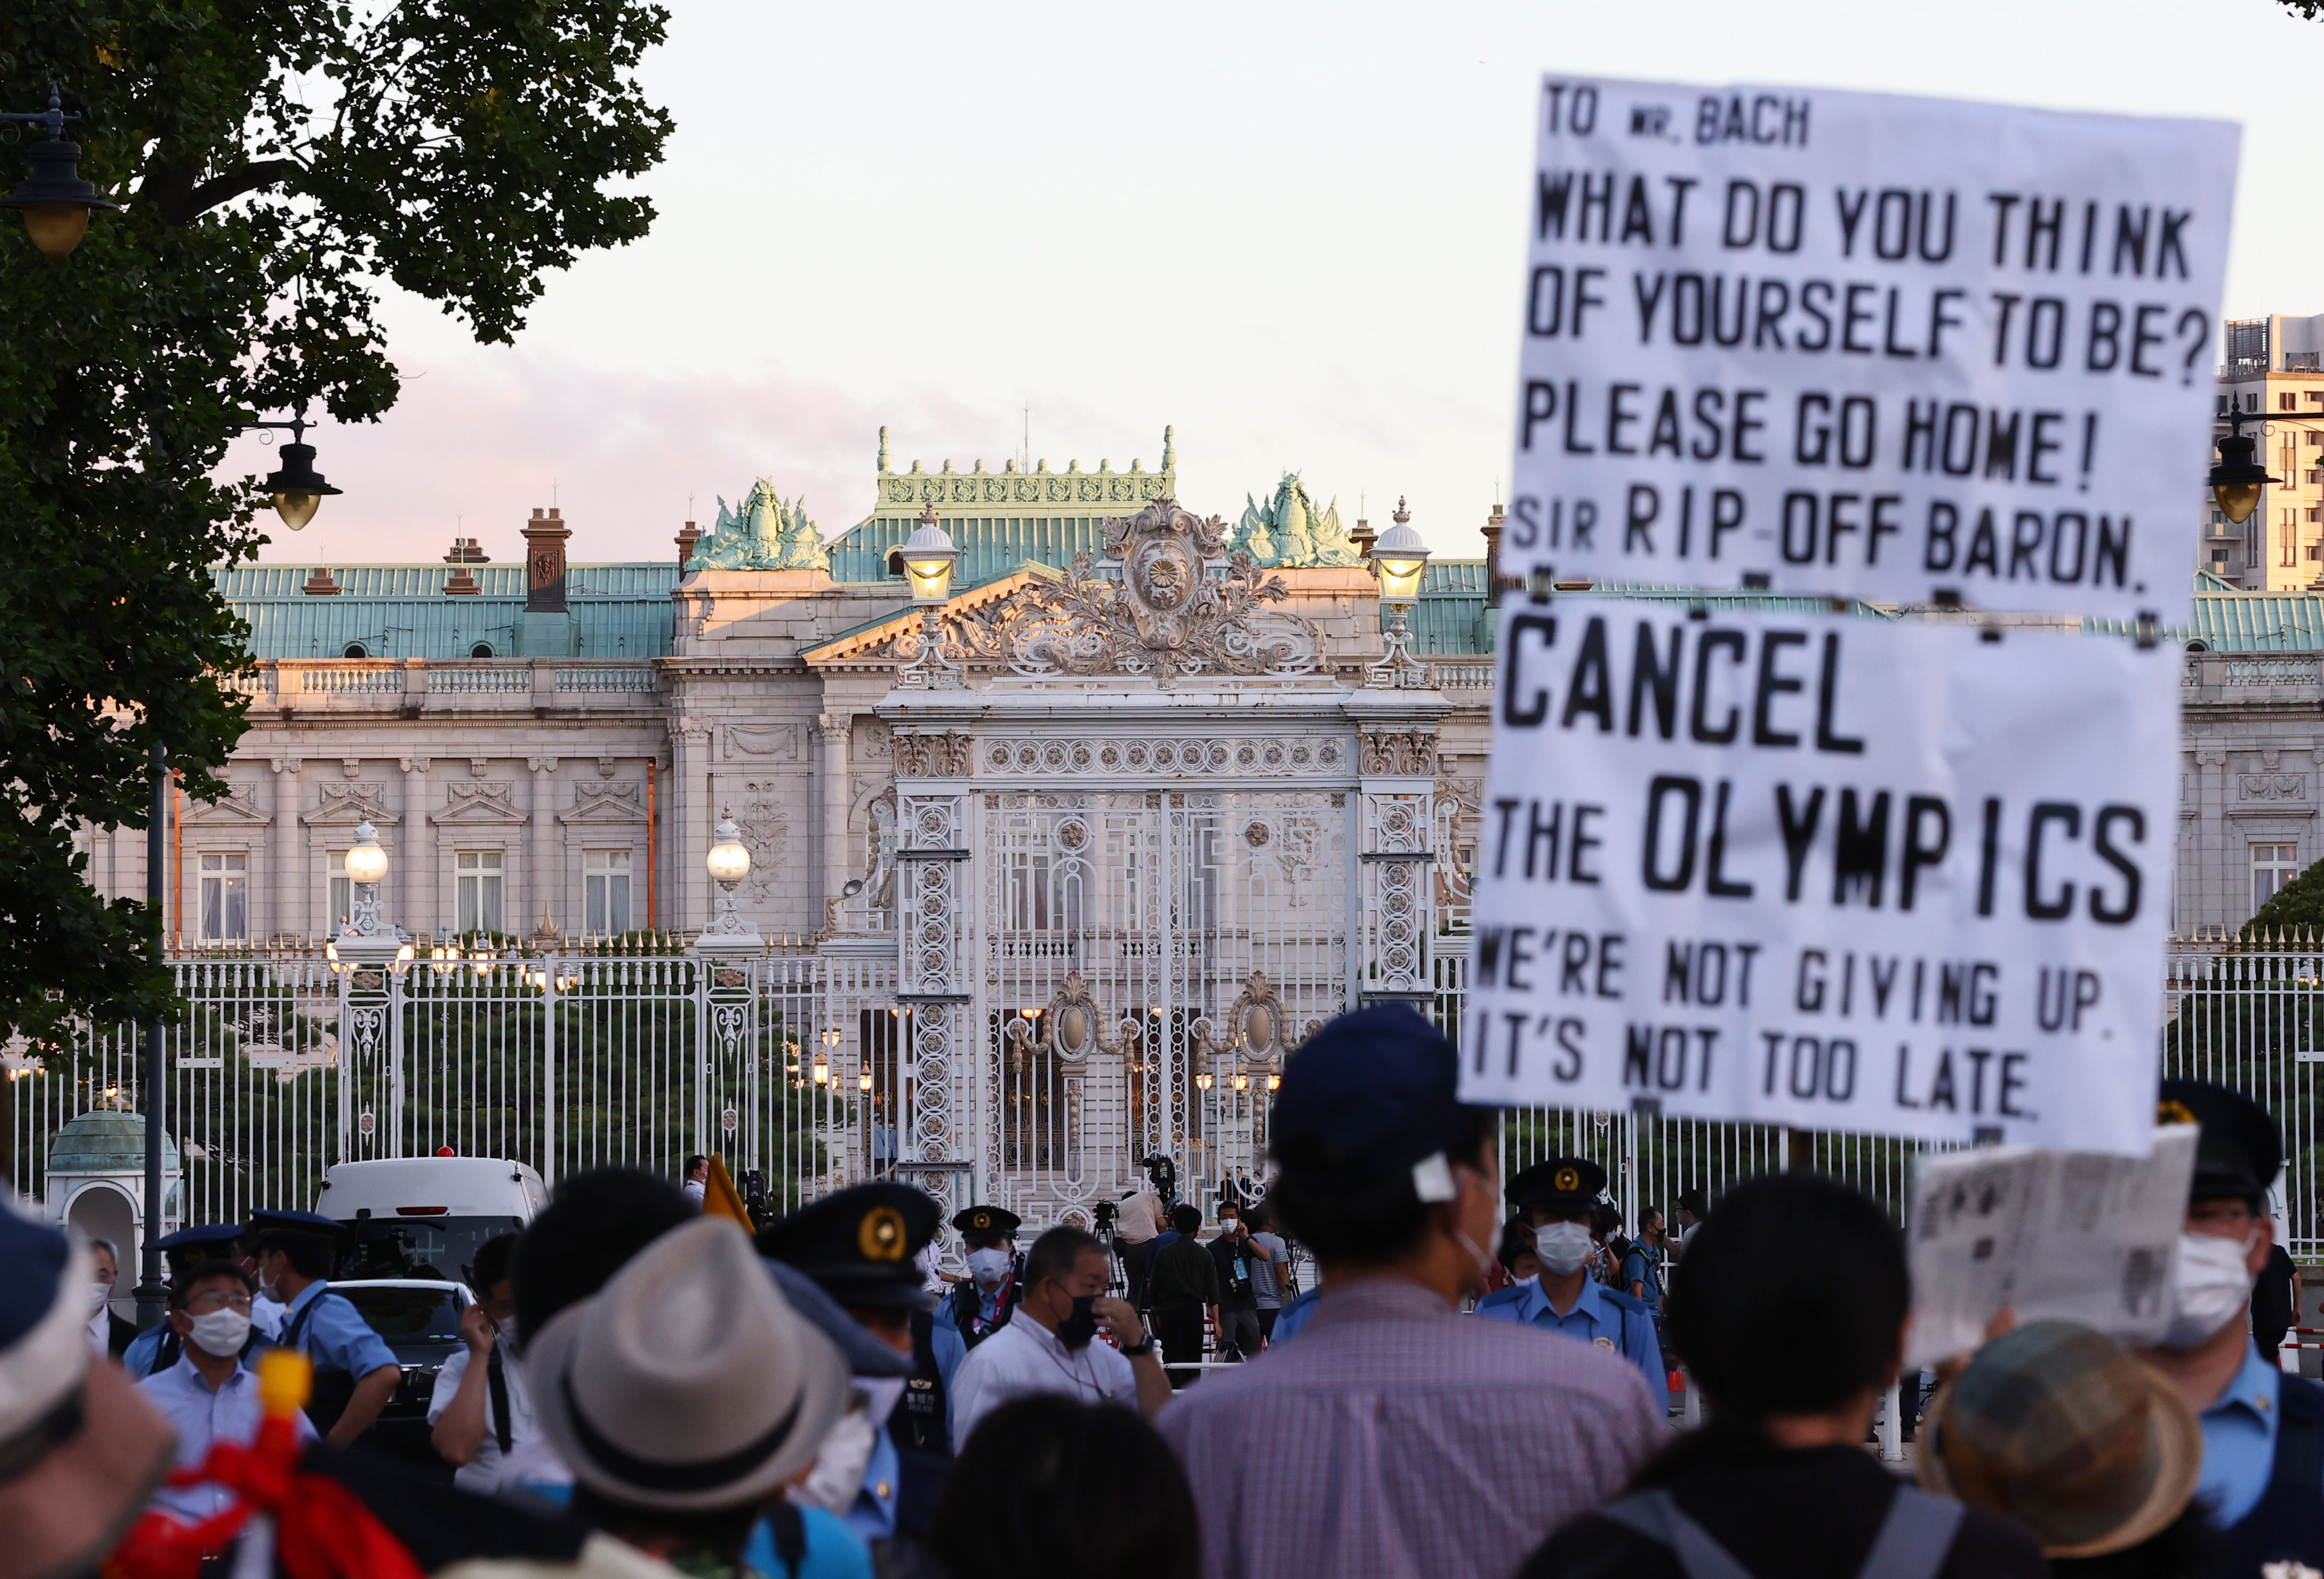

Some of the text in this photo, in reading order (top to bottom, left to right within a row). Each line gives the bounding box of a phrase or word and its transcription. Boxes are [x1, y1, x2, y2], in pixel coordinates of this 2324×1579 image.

[1547, 82, 1599, 137] TO
[1695, 95, 1810, 147] BACH
[1537, 170, 2192, 280] WHAT DO YOU THINK
[1526, 263, 2210, 386] OF YOURSELF TO BE?
[1520, 377, 2099, 493] PLEASE GO HOME!
[1512, 482, 2146, 594] SIR RIP-OFF BARON.
[1504, 613, 1867, 755] CANCEL
[1493, 772, 2148, 928] THE OLYMPICS
[1476, 926, 2113, 1039] WE'RE NOT GIVING UP.
[1475, 1011, 2040, 1121] IT'S NOT TOO LATE.
